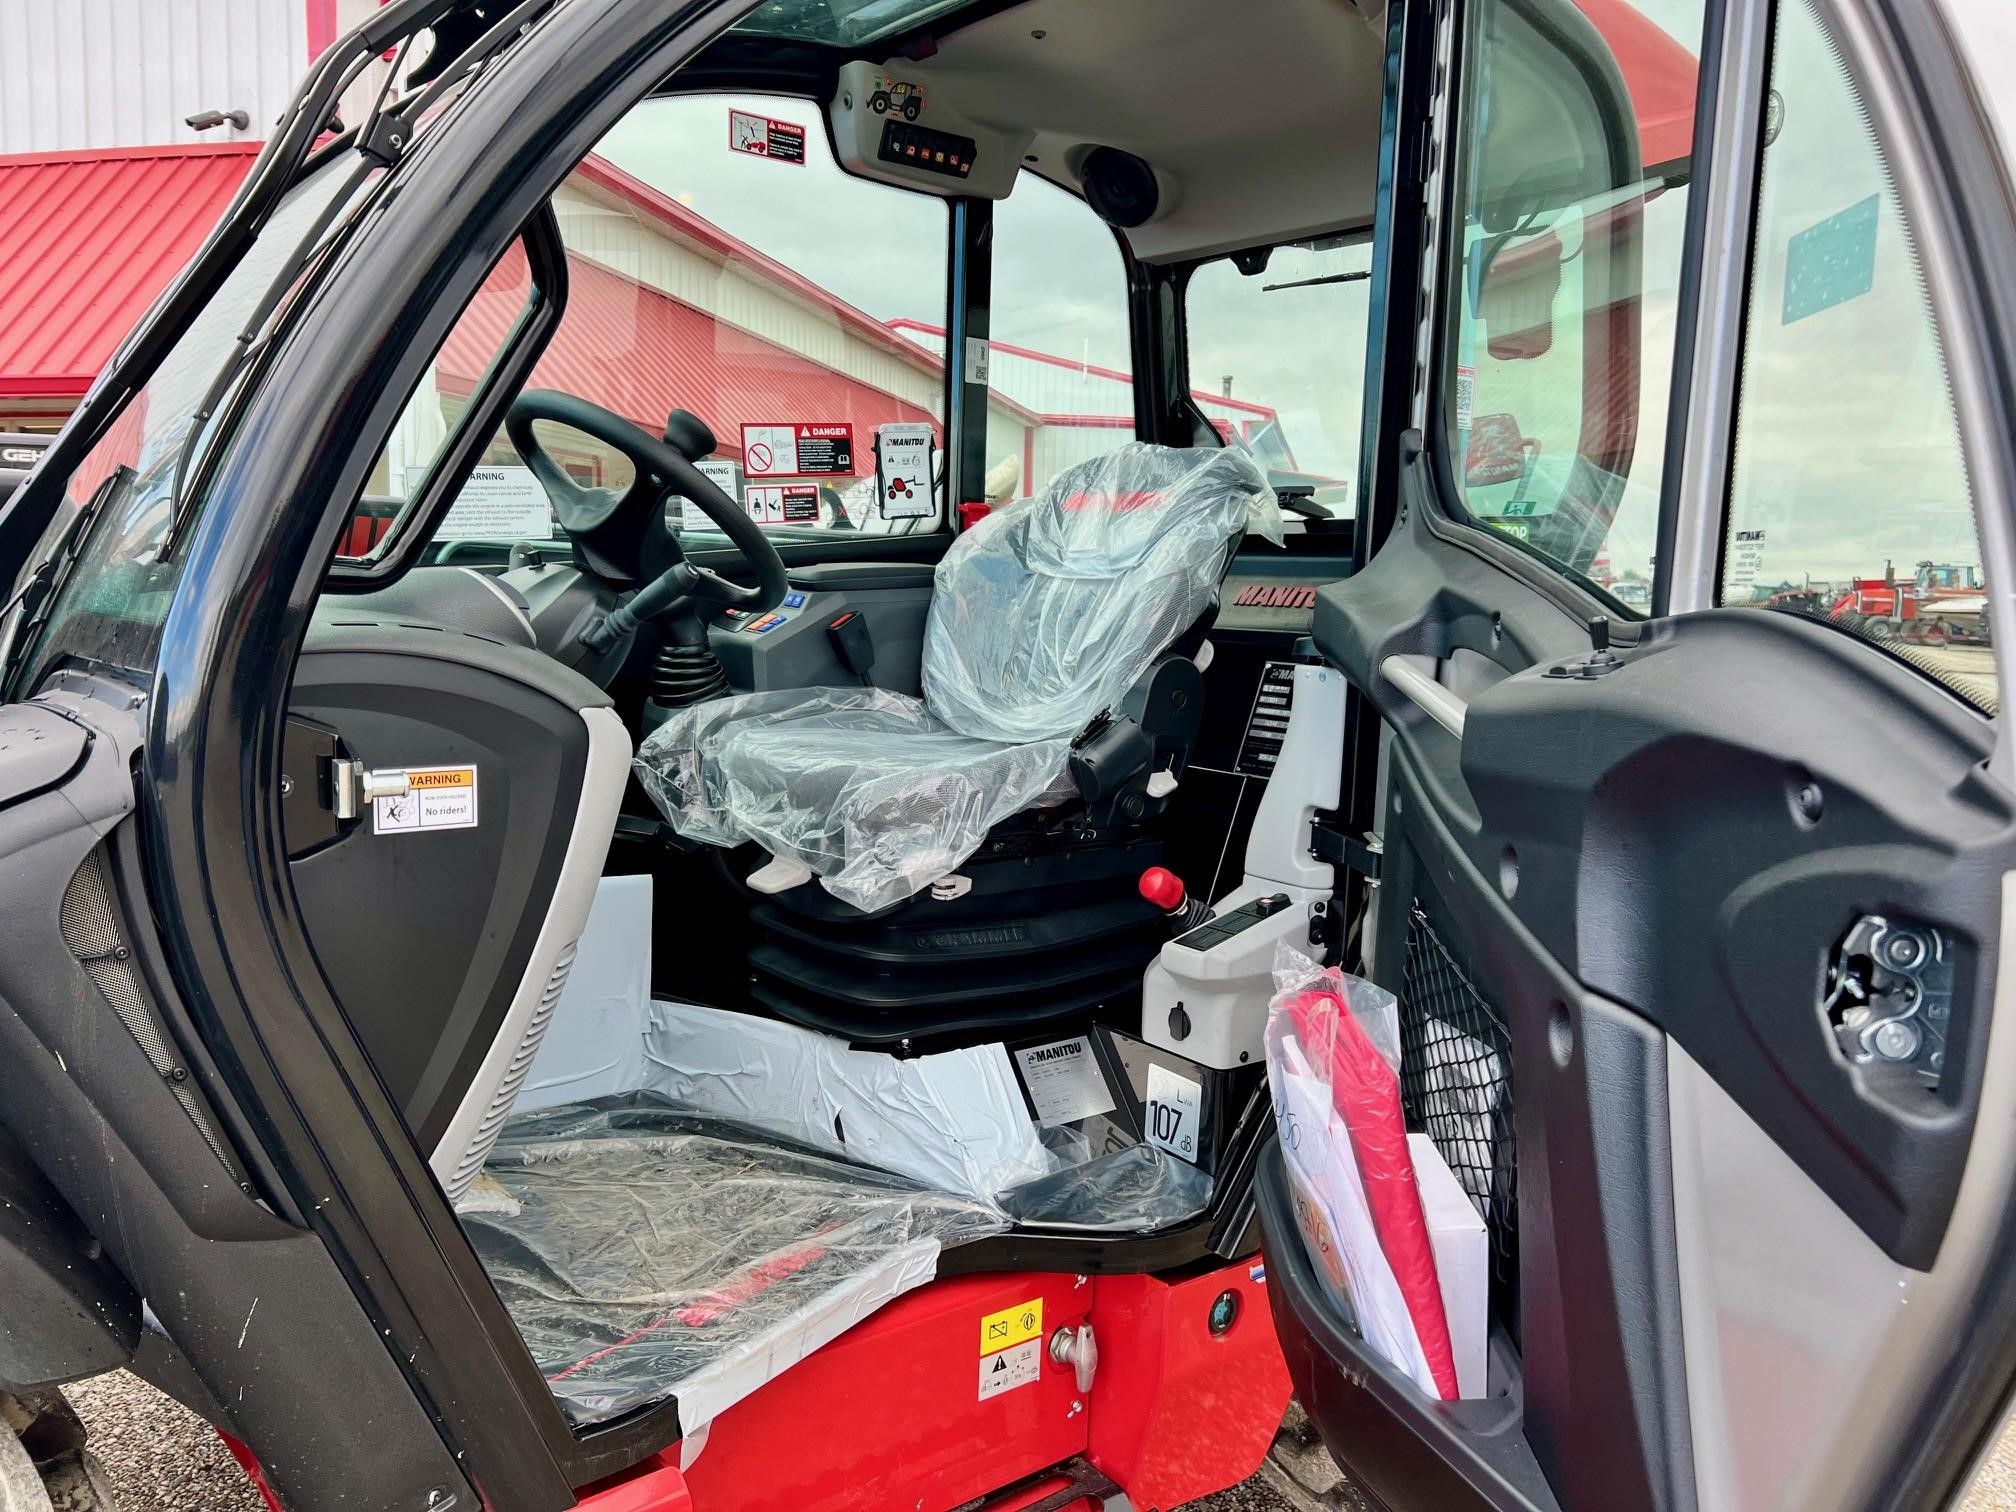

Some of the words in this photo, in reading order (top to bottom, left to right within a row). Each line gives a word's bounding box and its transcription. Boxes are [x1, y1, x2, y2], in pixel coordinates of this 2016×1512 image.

[777, 123, 802, 134] DANGER
[812, 427, 847, 436] DANGER
[891, 438, 925, 447] MANITOU
[1, 448, 47, 462] GEH
[698, 467, 729, 475] ARNING
[469, 472, 505, 481] ARNING
[425, 807, 438, 816] No
[440, 806, 467, 814] riders!
[1035, 1042, 1082, 1062] MANITOU
[1150, 1100, 1183, 1145] 107
[1180, 1134, 1192, 1153] dB
